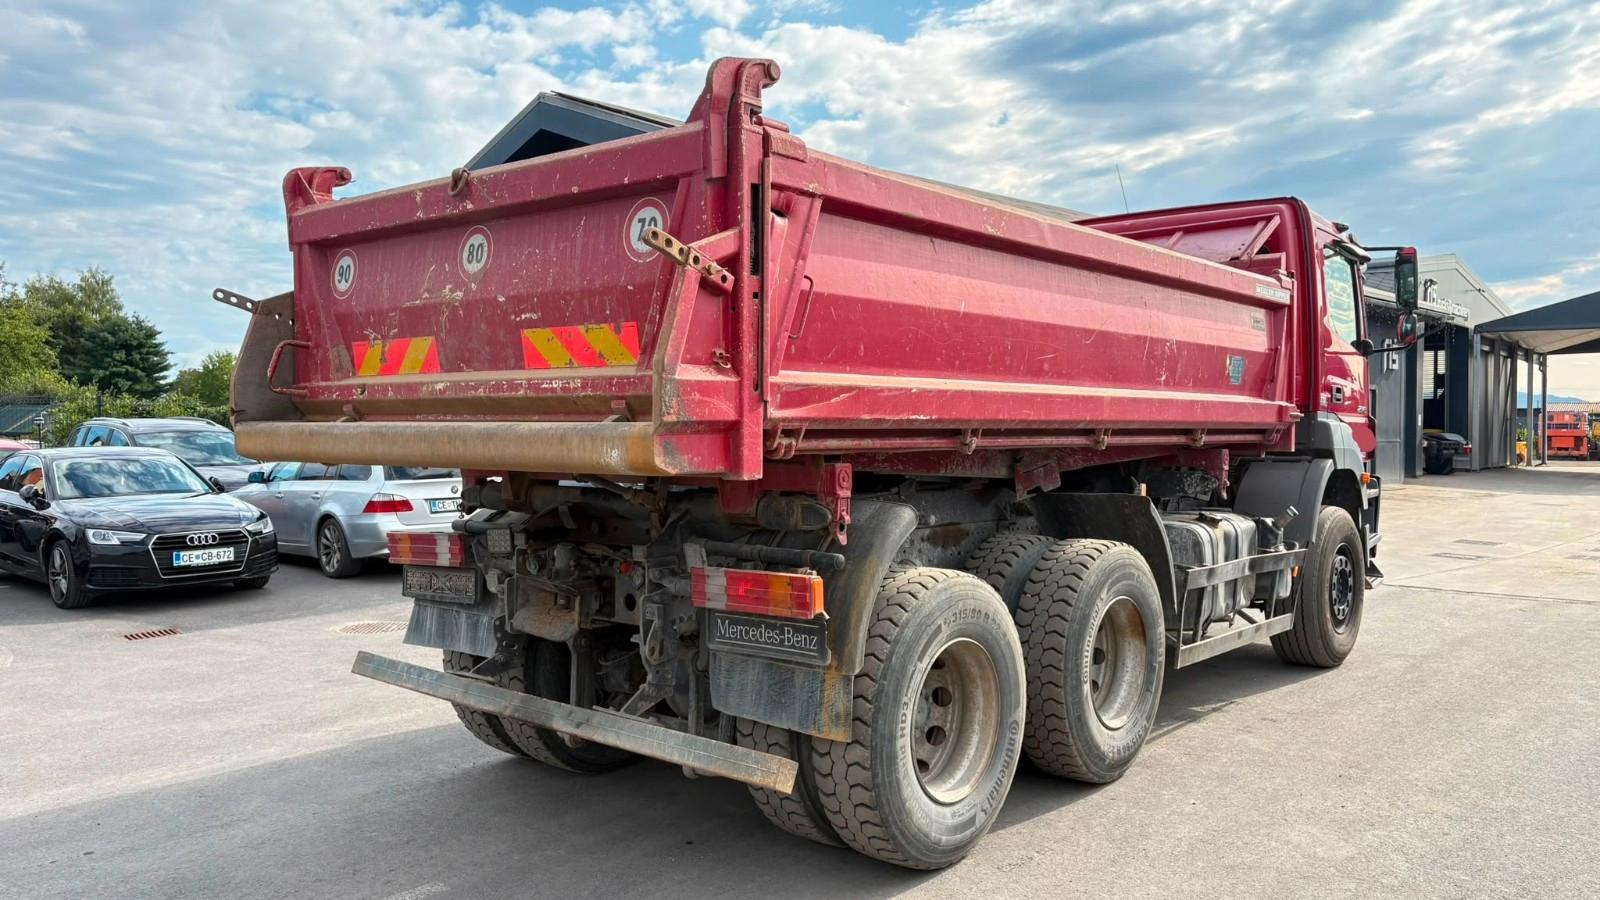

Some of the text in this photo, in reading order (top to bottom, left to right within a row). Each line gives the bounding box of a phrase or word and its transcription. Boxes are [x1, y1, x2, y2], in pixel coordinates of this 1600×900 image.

[466, 243, 485, 265] 80
[337, 264, 351, 284] 90
[182, 550, 232, 563] CE CB-672
[952, 607, 982, 624] 315/80
[716, 618, 819, 650] Mercedes-Benz
[899, 700, 909, 739] HD3
[988, 719, 1020, 811] Continental
